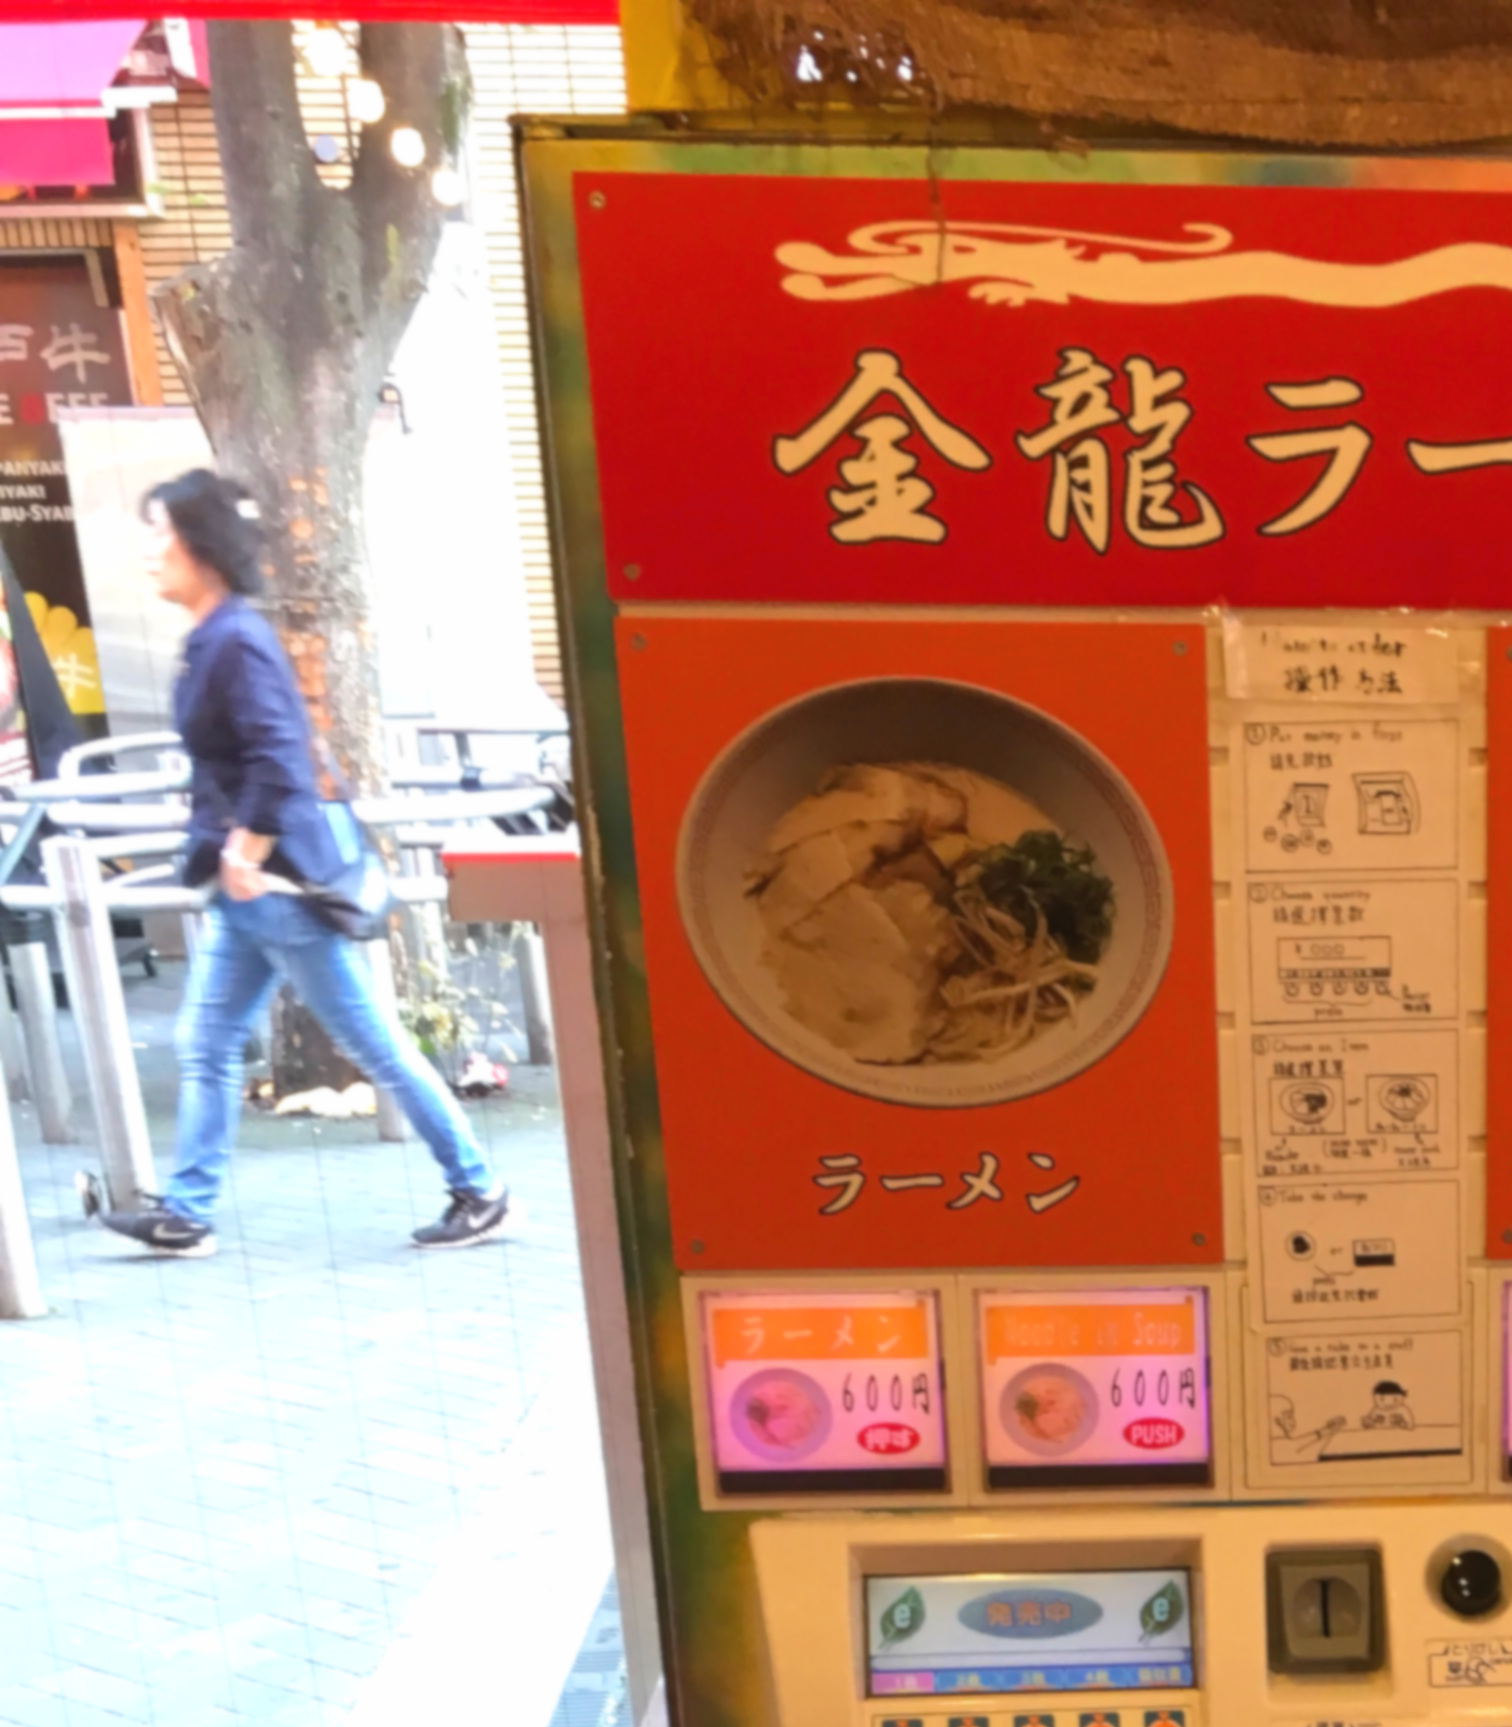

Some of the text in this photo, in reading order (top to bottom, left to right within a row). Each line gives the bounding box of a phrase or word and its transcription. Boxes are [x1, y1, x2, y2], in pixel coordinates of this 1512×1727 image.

[812, 1152, 1081, 1216] ラーメン
[740, 1313, 902, 1355] ラーメン
[1132, 1311, 1182, 1349] Soup
[1131, 1424, 1178, 1445] PUSH
